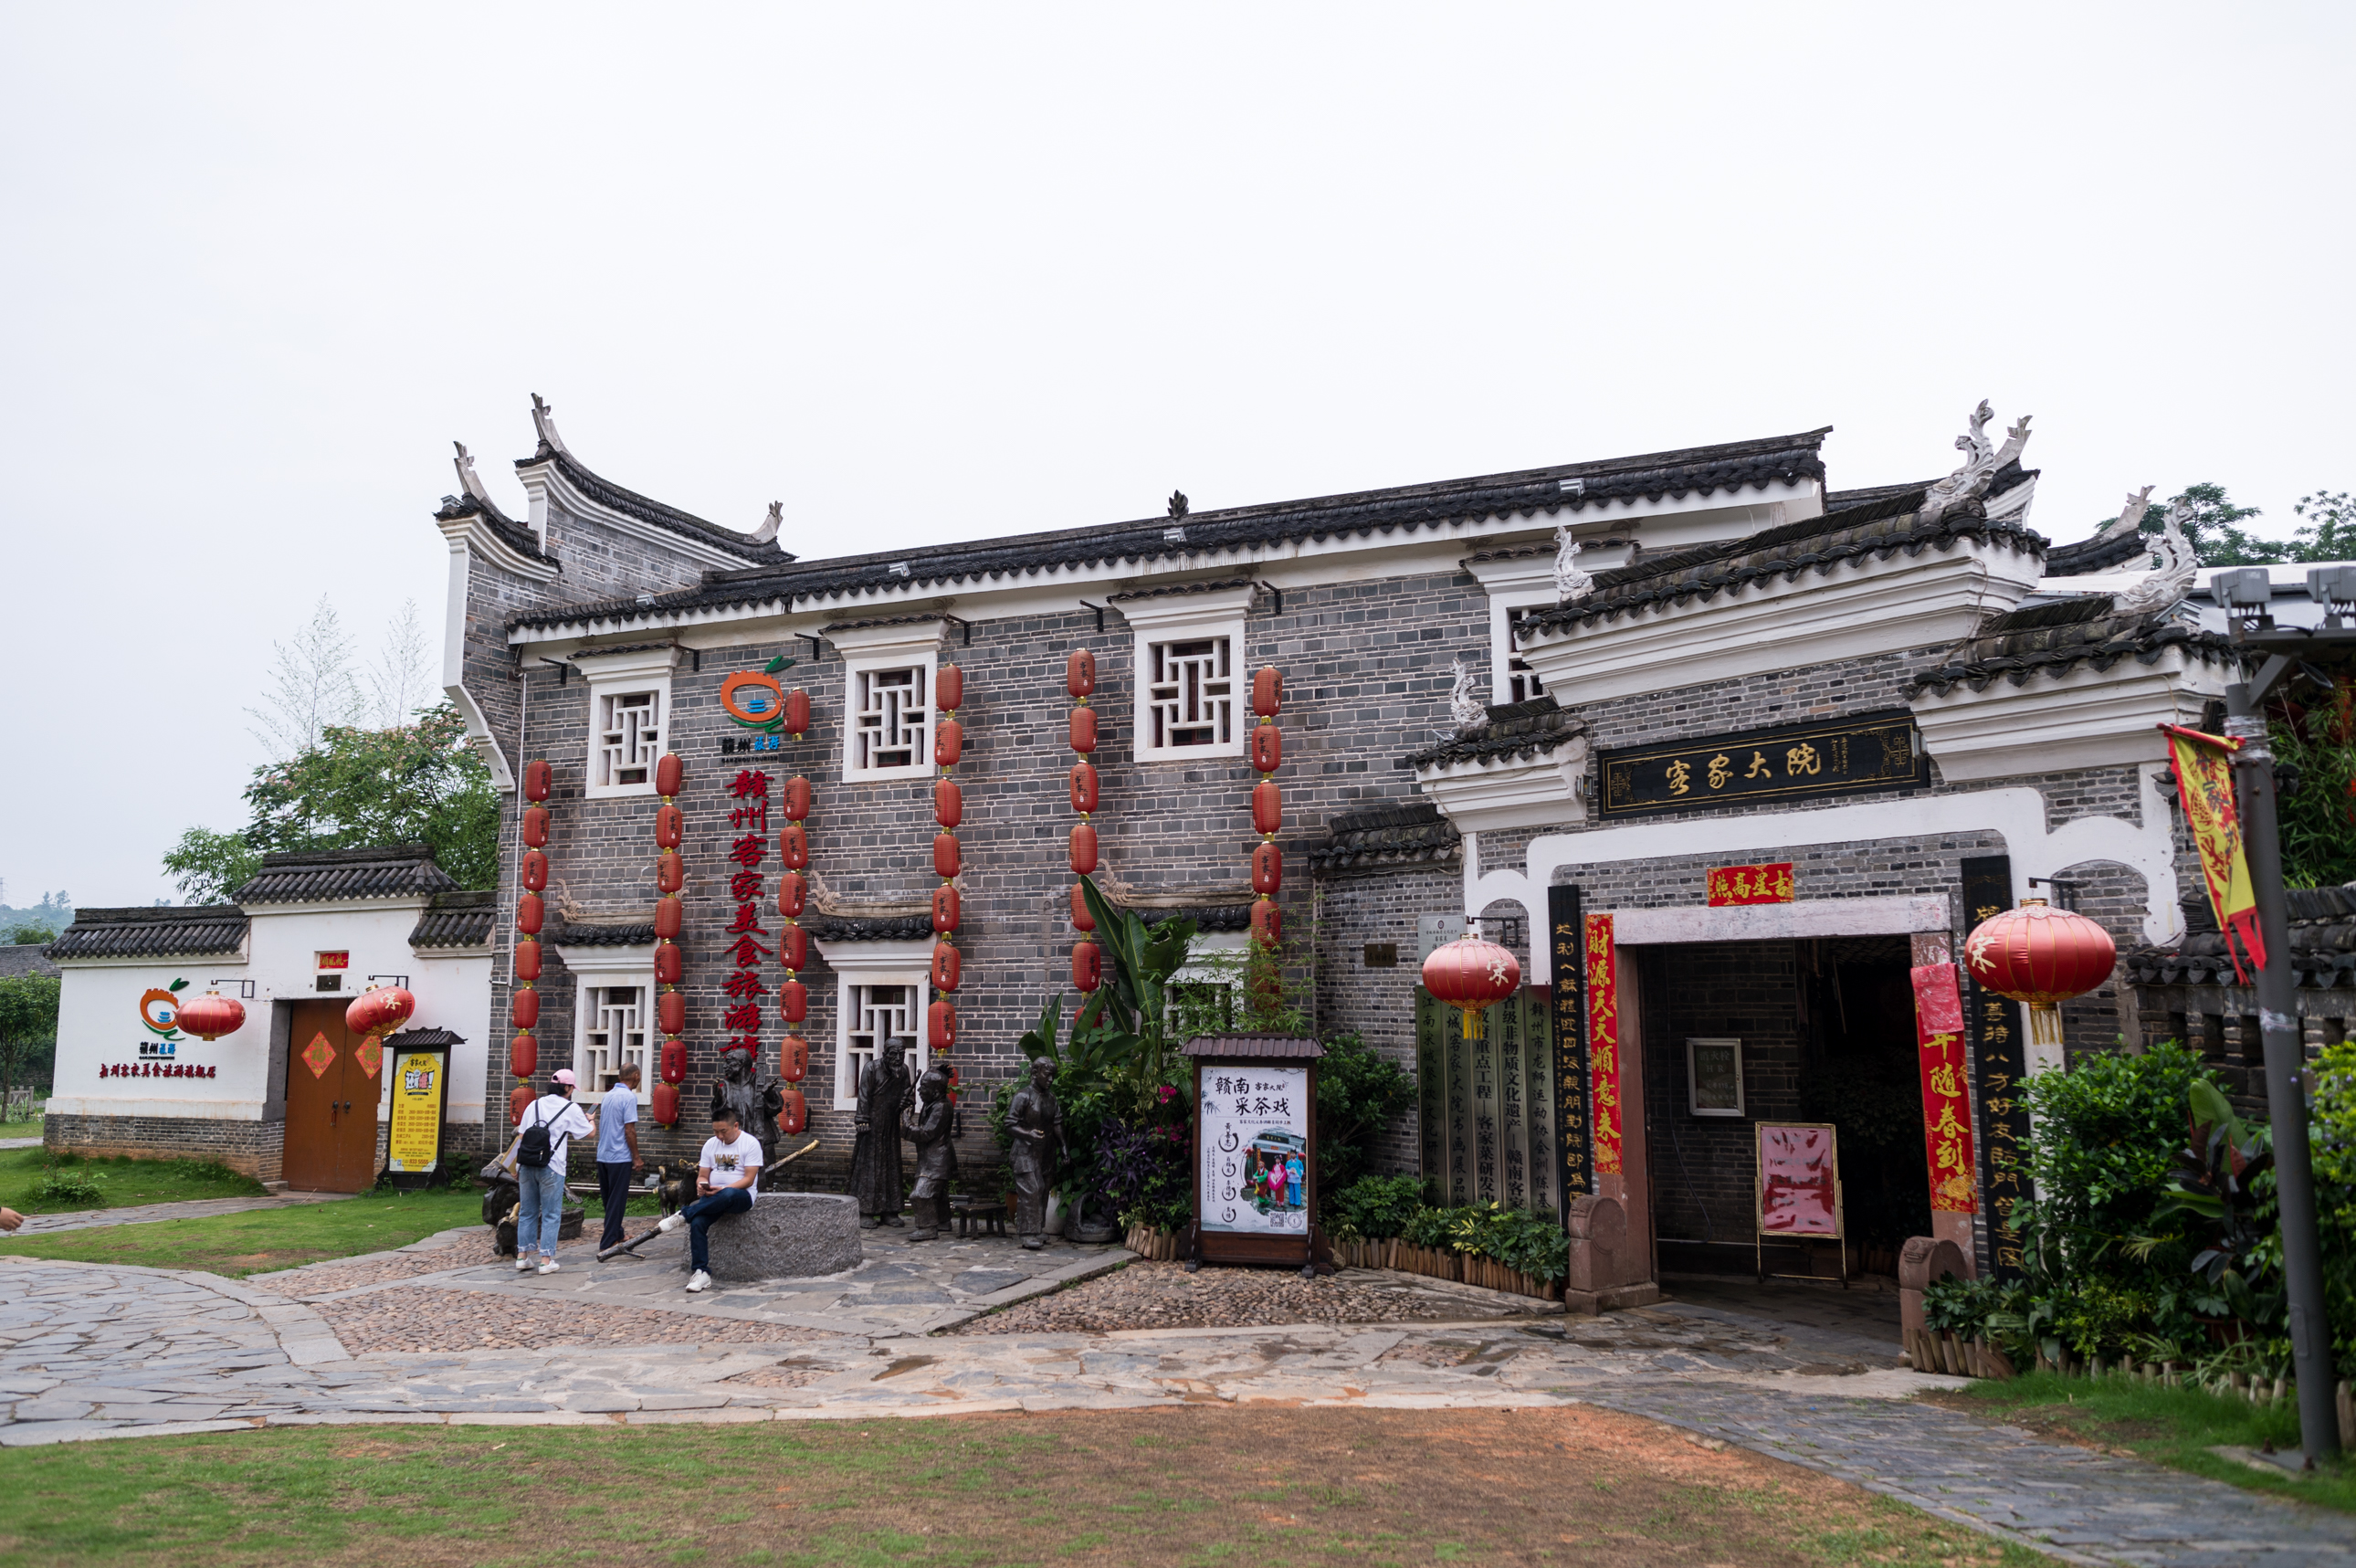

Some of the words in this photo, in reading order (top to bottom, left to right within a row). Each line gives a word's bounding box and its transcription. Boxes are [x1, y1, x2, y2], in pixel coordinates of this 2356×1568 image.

[1665, 742, 1822, 796] 客家大院
[1710, 869, 1790, 900] 吉星高照
[1235, 1097, 1290, 1116] 采茶戏
[714, 1154, 739, 1165] WAKE
